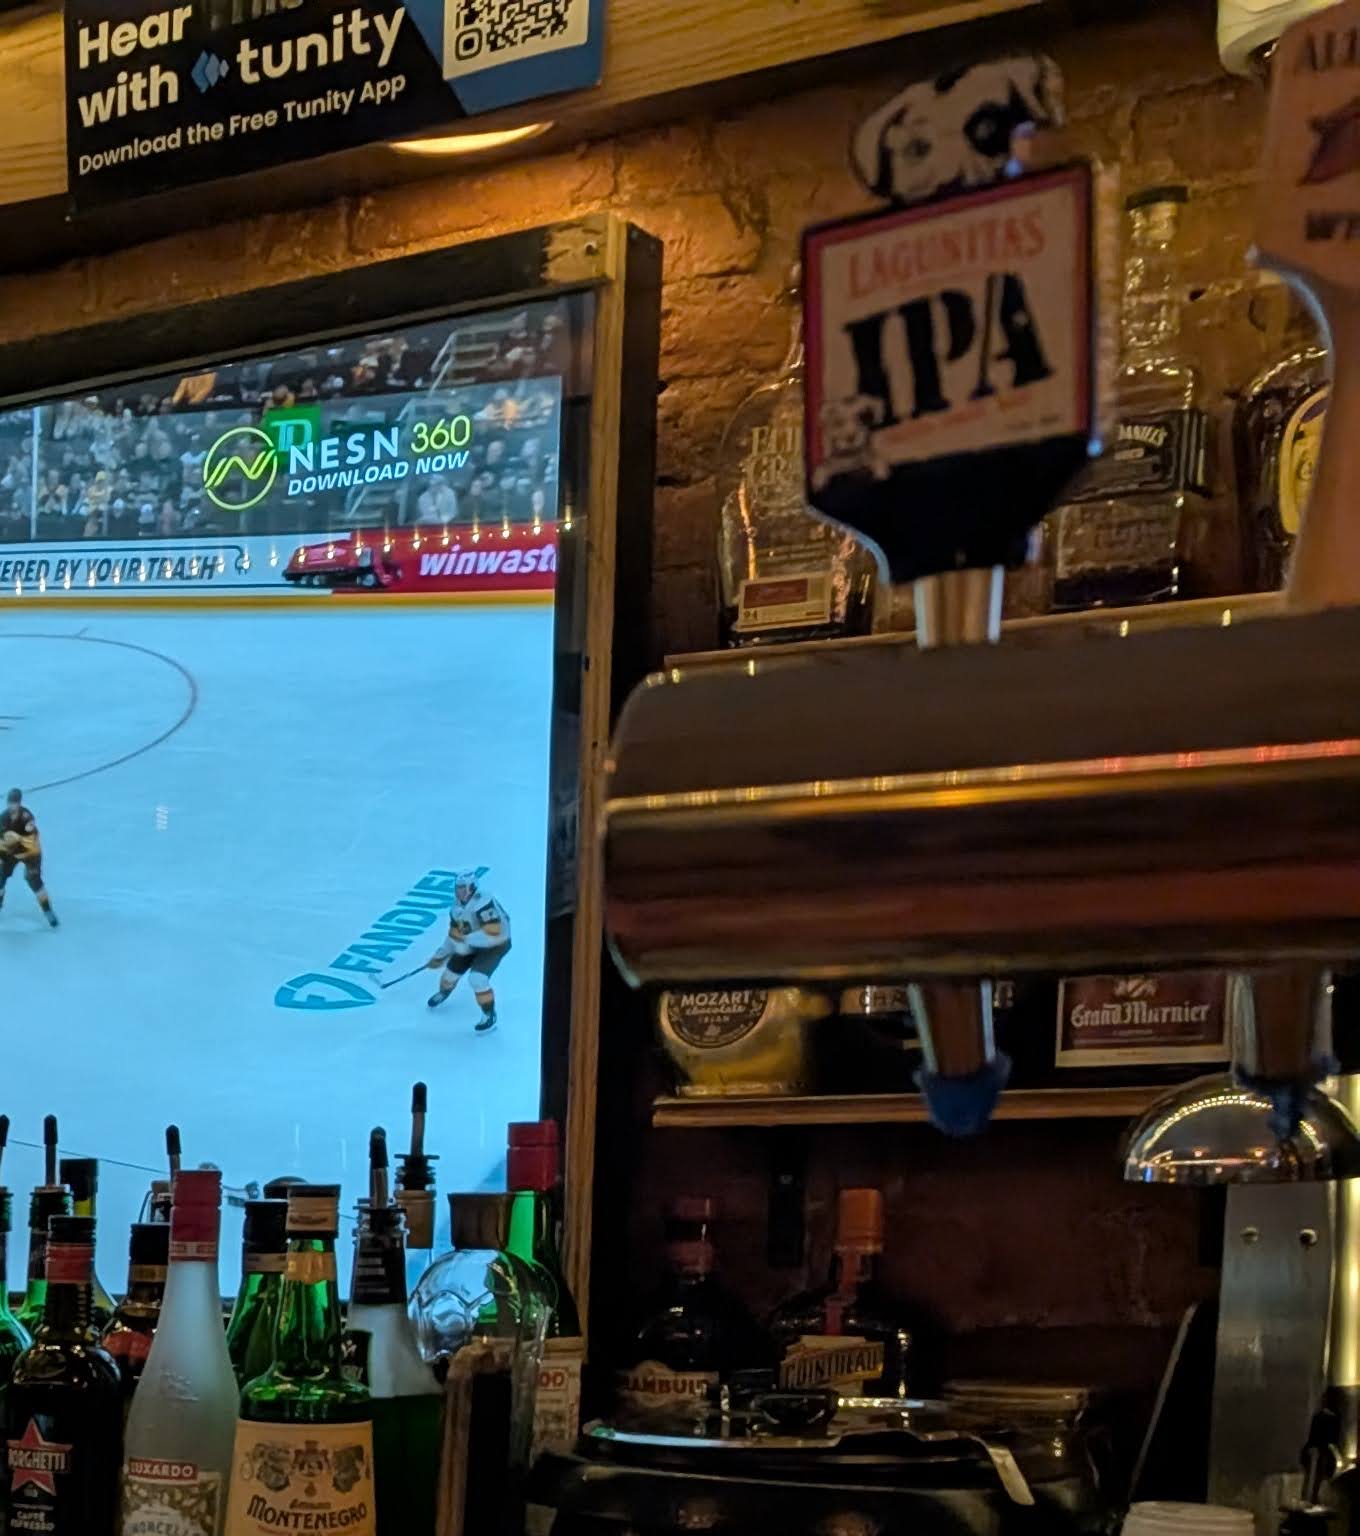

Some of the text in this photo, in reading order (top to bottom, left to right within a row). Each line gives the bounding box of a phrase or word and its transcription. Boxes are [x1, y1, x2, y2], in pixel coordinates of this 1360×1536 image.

[77, 65, 179, 128] with
[236, 7, 406, 86] tunity
[79, 3, 192, 69] Hear
[79, 73, 406, 176] Download the Free Tunity App
[850, 209, 1045, 299] LAGUNITAS
[845, 273, 1052, 430] IPA
[288, 450, 470, 496] DOWNLOAD NOW
[289, 414, 471, 474] NESN 360
[55, 557, 83, 582] BY
[86, 556, 146, 582] YOUR
[147, 555, 217, 581] TRASH
[681, 986, 752, 1009] MOZART
[247, 1494, 368, 1530] MONTENEGRO
